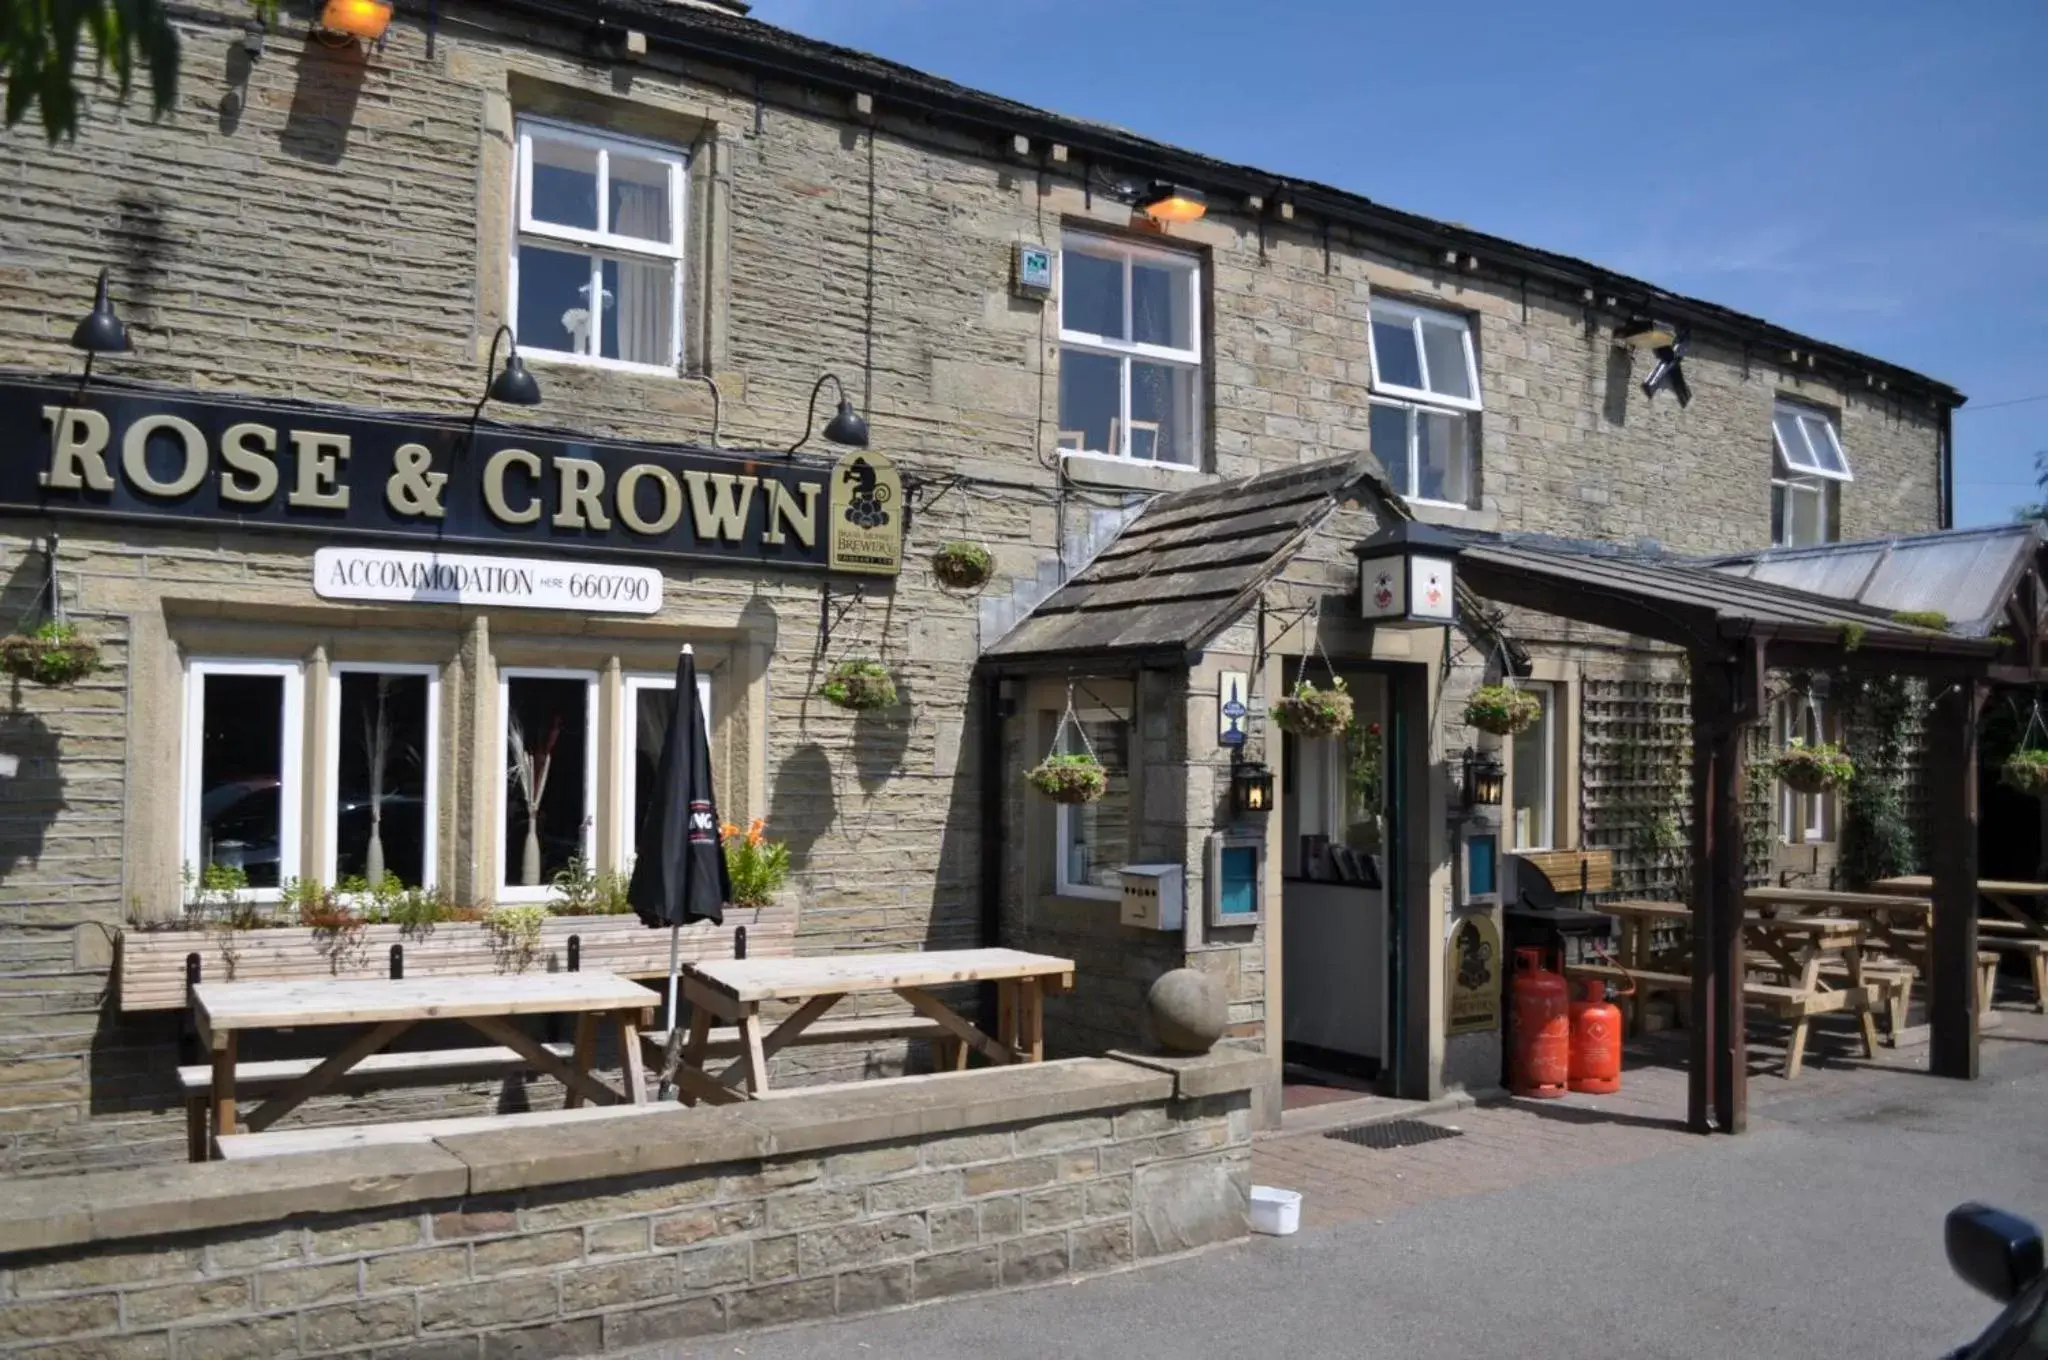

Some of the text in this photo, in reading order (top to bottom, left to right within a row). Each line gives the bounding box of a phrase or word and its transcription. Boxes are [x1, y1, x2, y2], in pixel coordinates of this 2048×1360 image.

[39, 405, 822, 547] ROSE & CROWN
[330, 558, 649, 601] ACCOMMODATION HERE 660790
